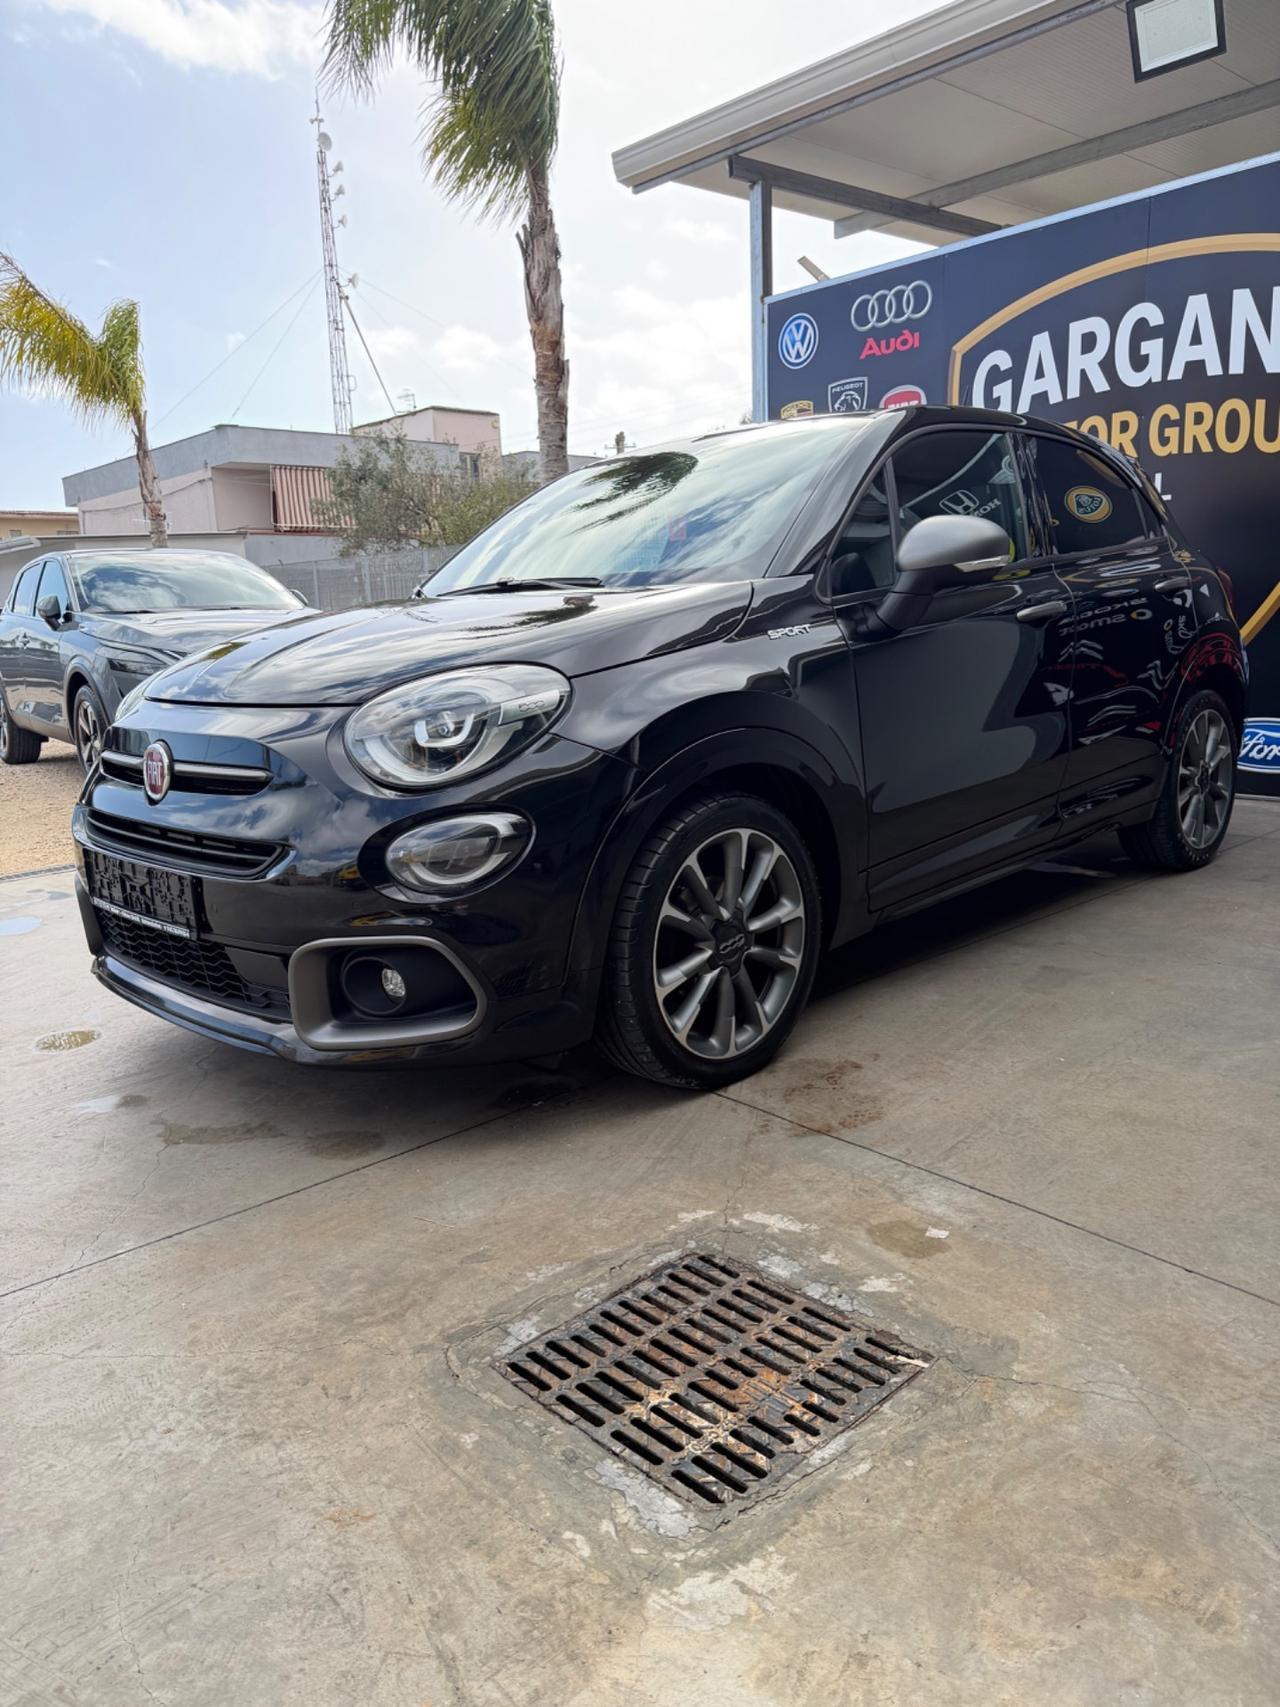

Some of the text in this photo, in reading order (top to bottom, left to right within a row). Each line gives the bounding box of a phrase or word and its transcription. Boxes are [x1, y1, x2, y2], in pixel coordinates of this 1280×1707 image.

[859, 328, 920, 360] Audi
[767, 624, 810, 640] SPORT
[1237, 728, 1280, 760] For
